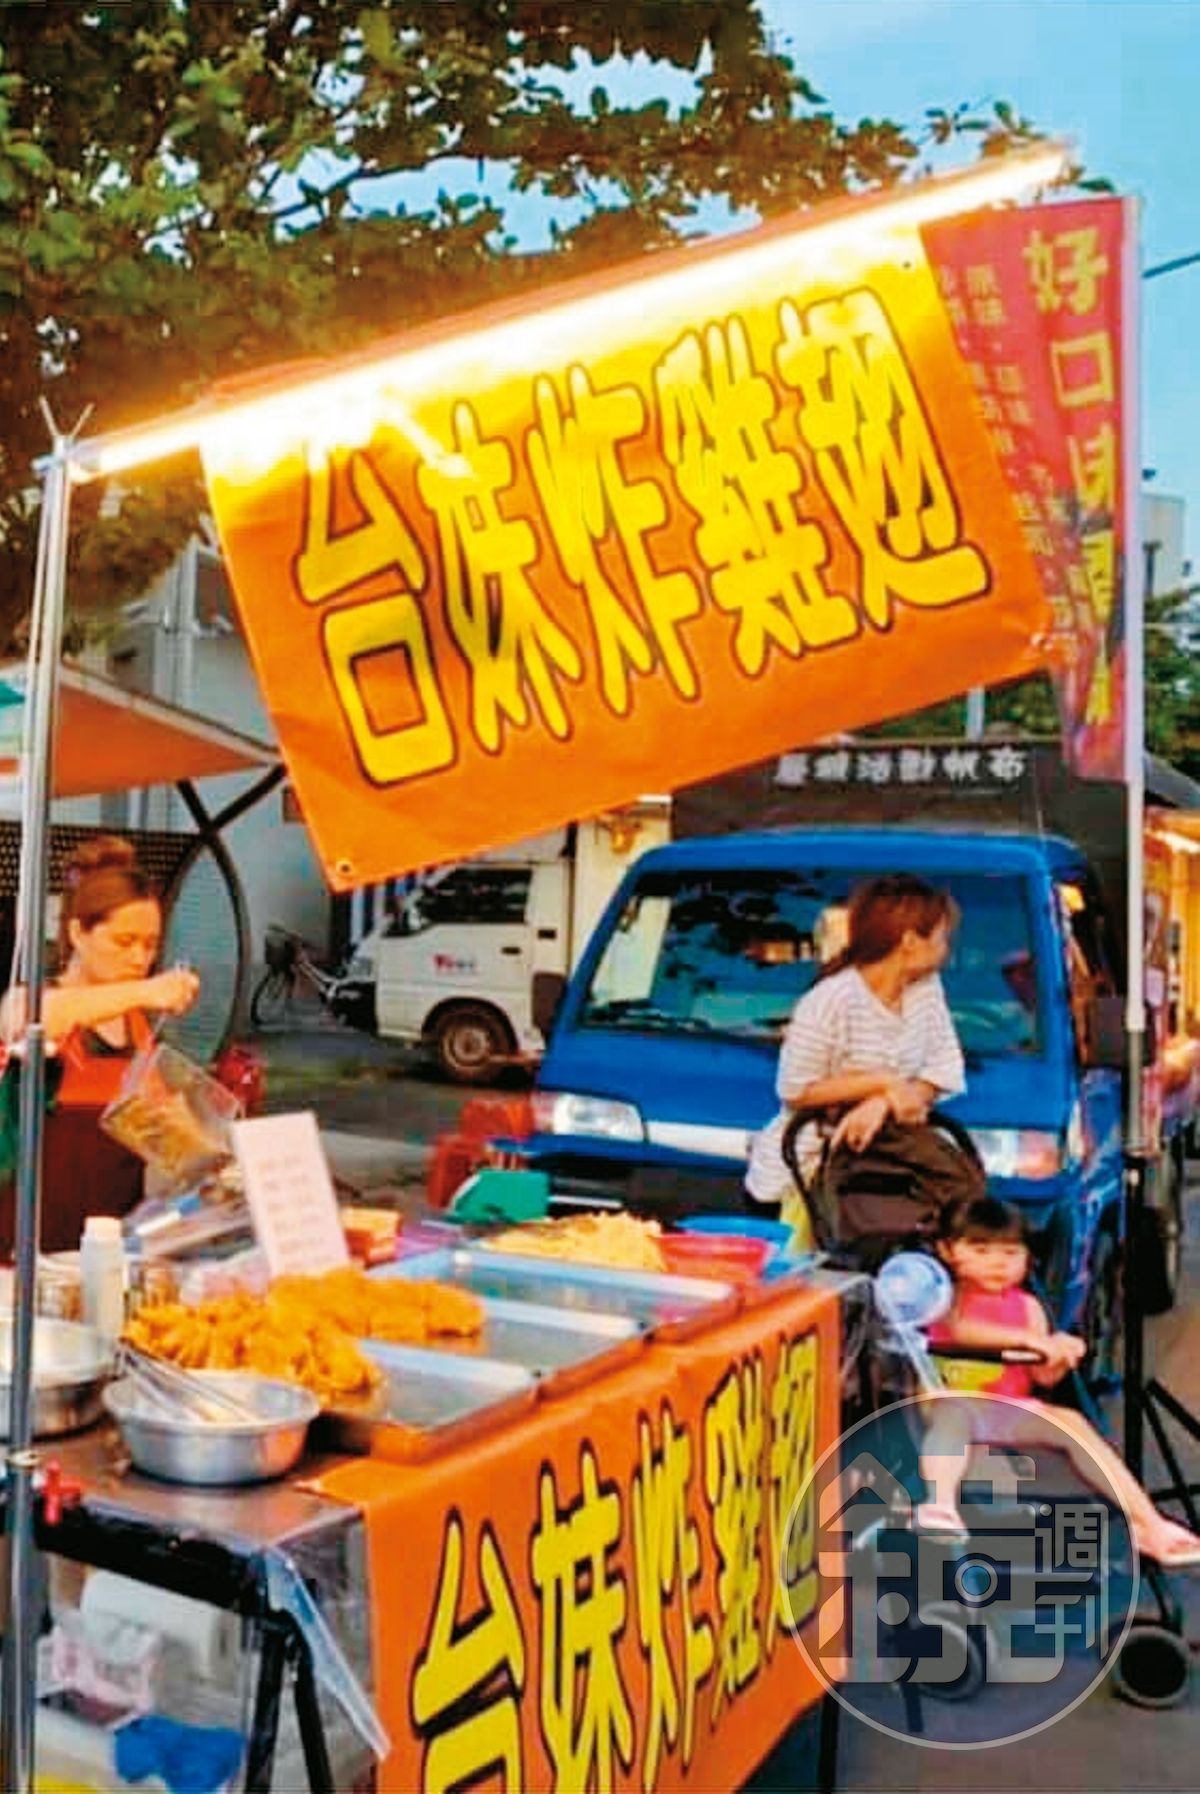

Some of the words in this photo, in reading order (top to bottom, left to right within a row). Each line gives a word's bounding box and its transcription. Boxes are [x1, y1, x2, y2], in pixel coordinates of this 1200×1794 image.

[293, 287, 990, 789] 台味炸雞翅
